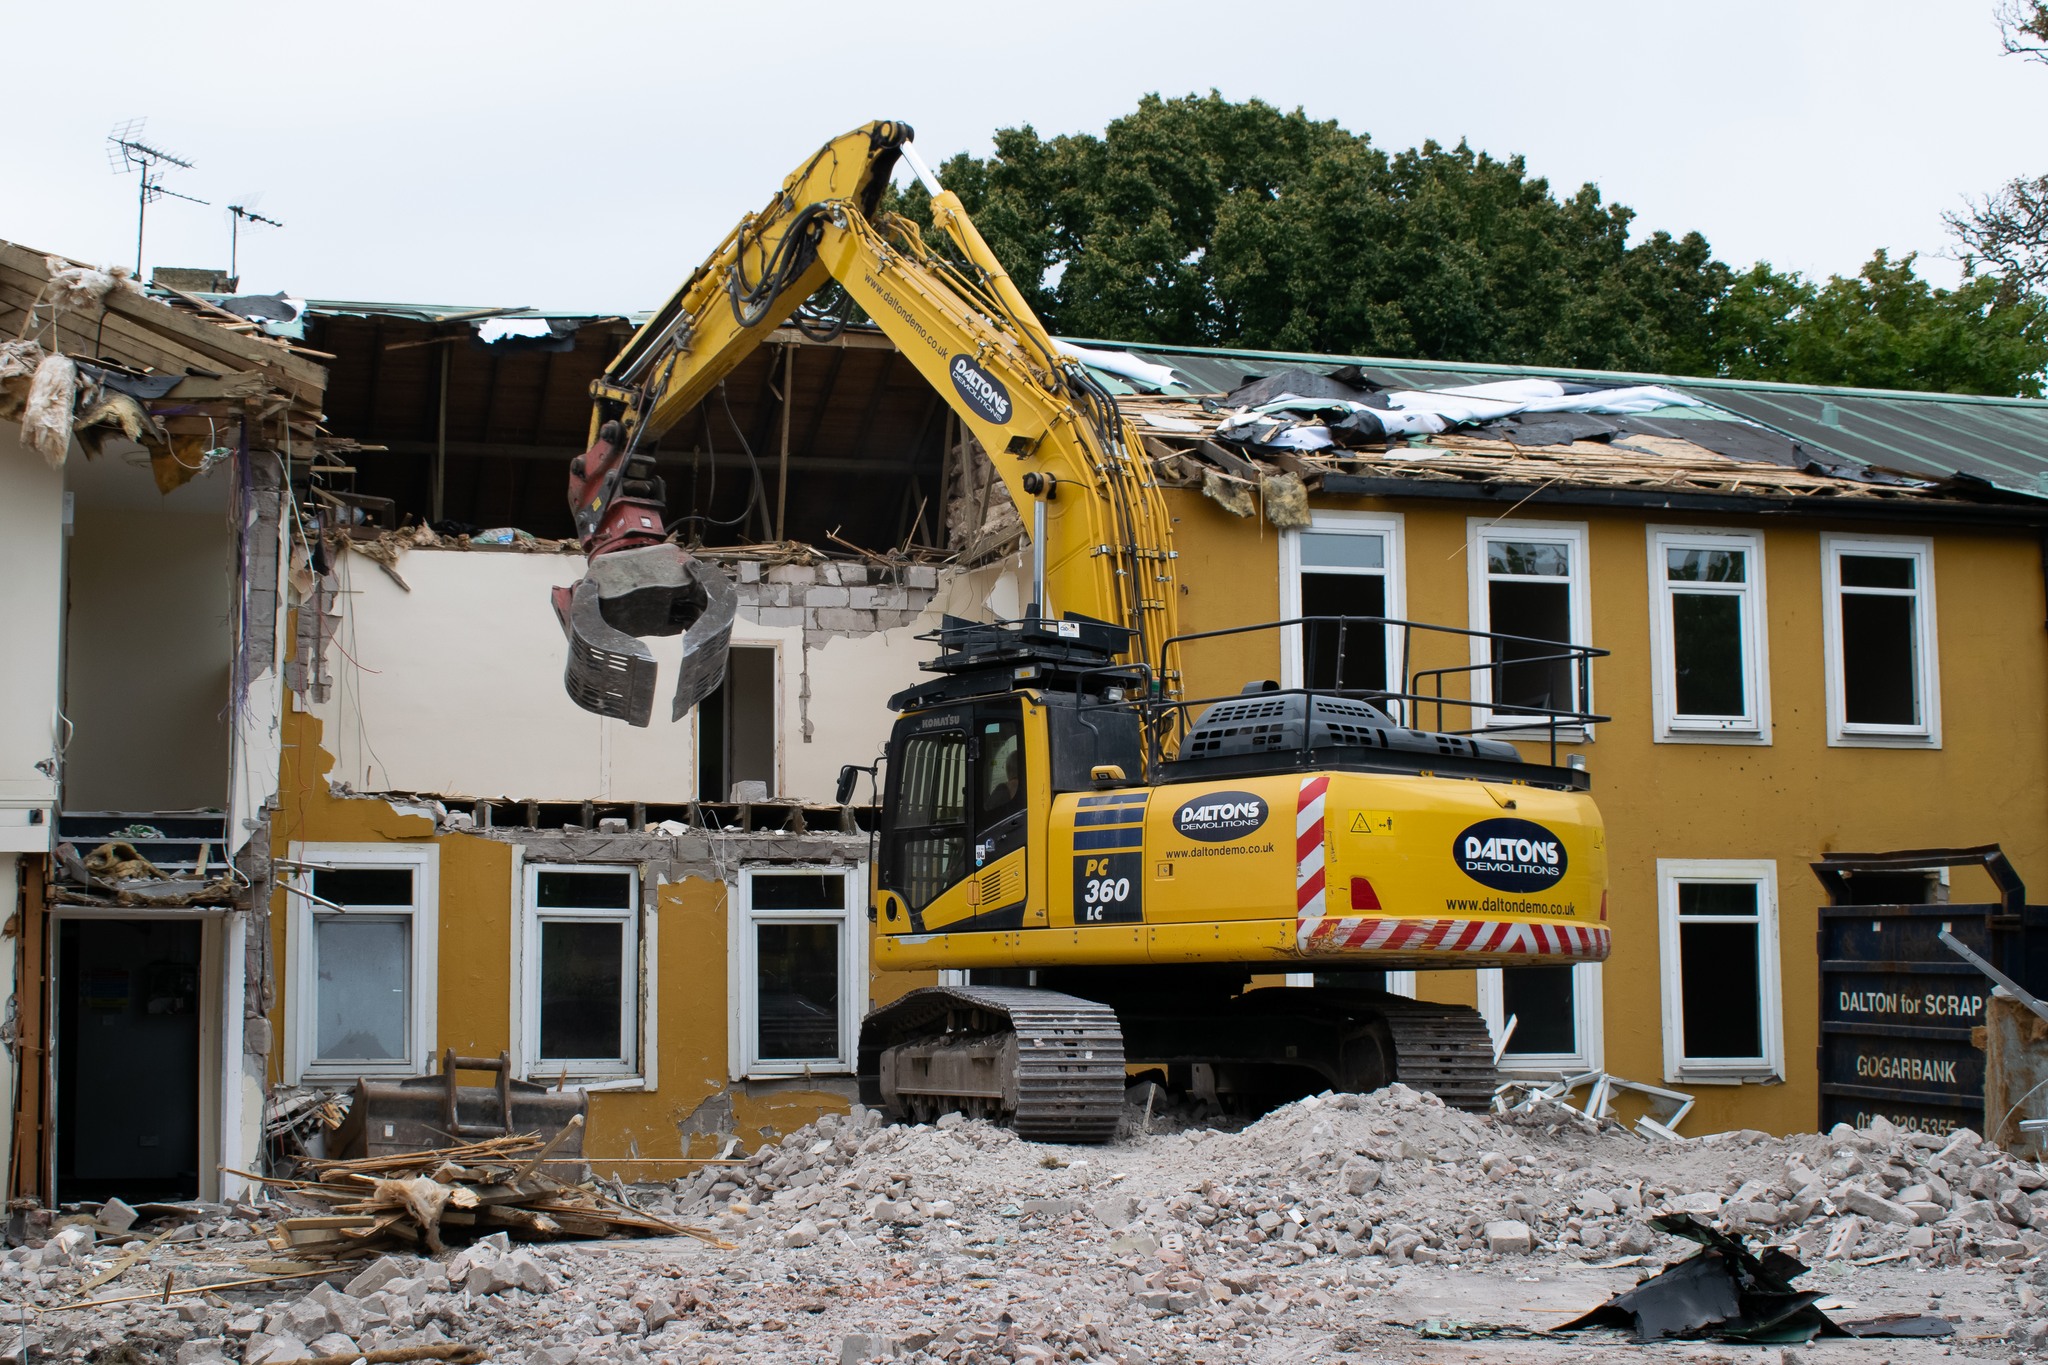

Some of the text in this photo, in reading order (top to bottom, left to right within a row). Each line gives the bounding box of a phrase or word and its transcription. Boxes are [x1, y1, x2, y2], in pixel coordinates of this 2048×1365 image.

[864, 272, 949, 361] www.daltondemo.co.uk
[952, 371, 1002, 422] DEMOLITIONS
[955, 359, 1009, 415] DALTONS
[921, 714, 960, 729] KOMATSU
[1181, 801, 1260, 823] DALTONS
[1180, 818, 1259, 831] DEMOLITIONS
[1165, 842, 1275, 859] www.daltondemo.co.uk
[1465, 836, 1559, 865] DALTONS
[1085, 858, 1109, 877] PC
[1465, 861, 1560, 876] DEMOLITIONS
[1084, 877, 1130, 904] 360
[1086, 905, 1104, 921] LC
[1446, 896, 1576, 916] www.daltondemo.co.uk
[1839, 991, 1983, 1017] DALTON for SCRAP
[1856, 1054, 1957, 1084] GOGARBANK
